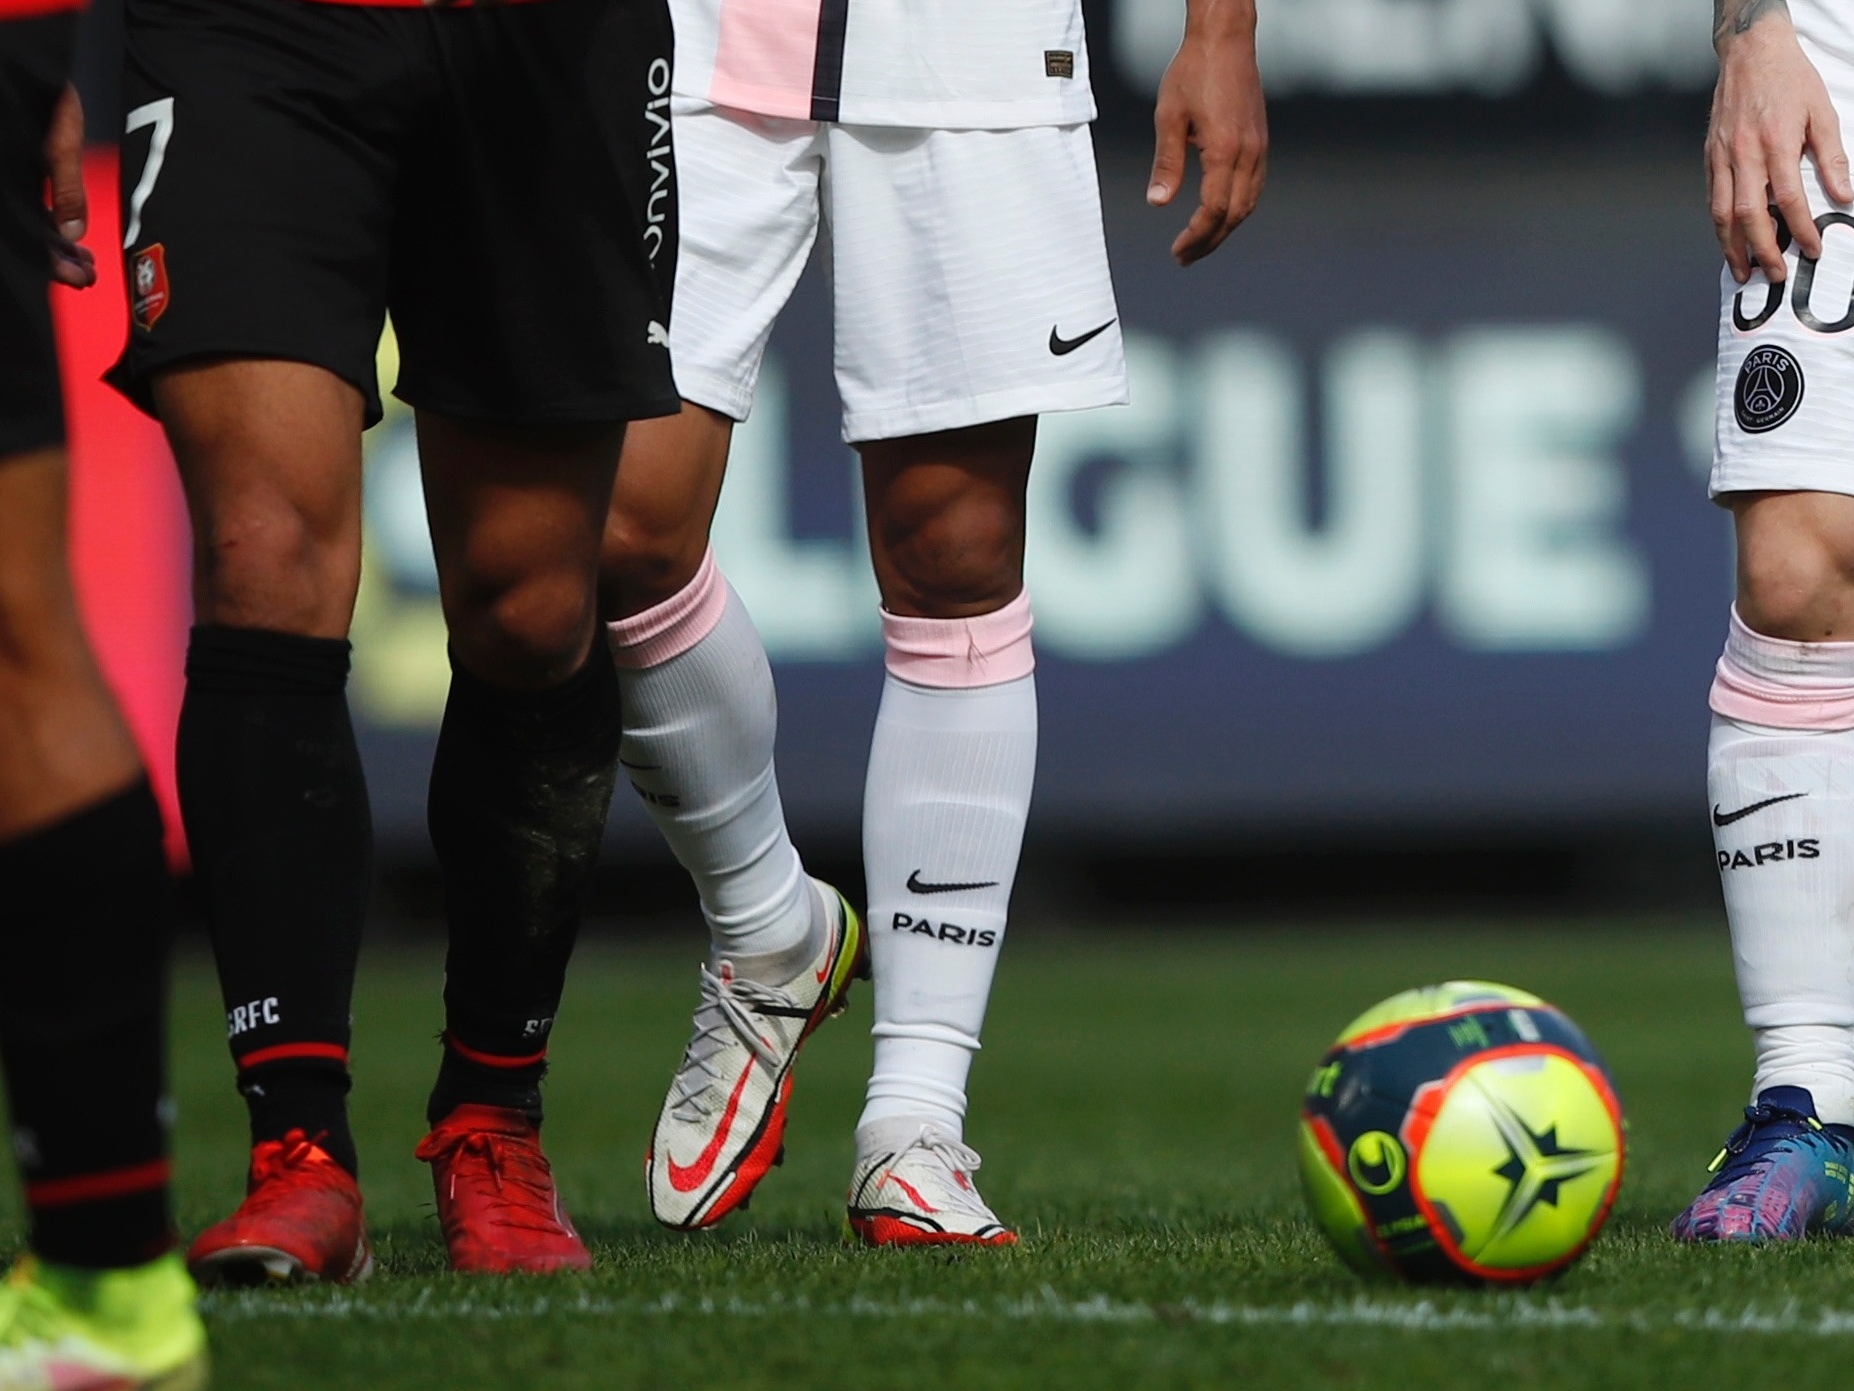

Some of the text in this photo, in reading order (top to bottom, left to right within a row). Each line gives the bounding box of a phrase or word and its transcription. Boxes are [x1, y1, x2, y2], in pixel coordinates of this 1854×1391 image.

[123, 96, 175, 250] 7
[1744, 352, 1789, 374] PARIS
[1717, 839, 1820, 871] PARIS
[892, 913, 996, 947] PARIS
